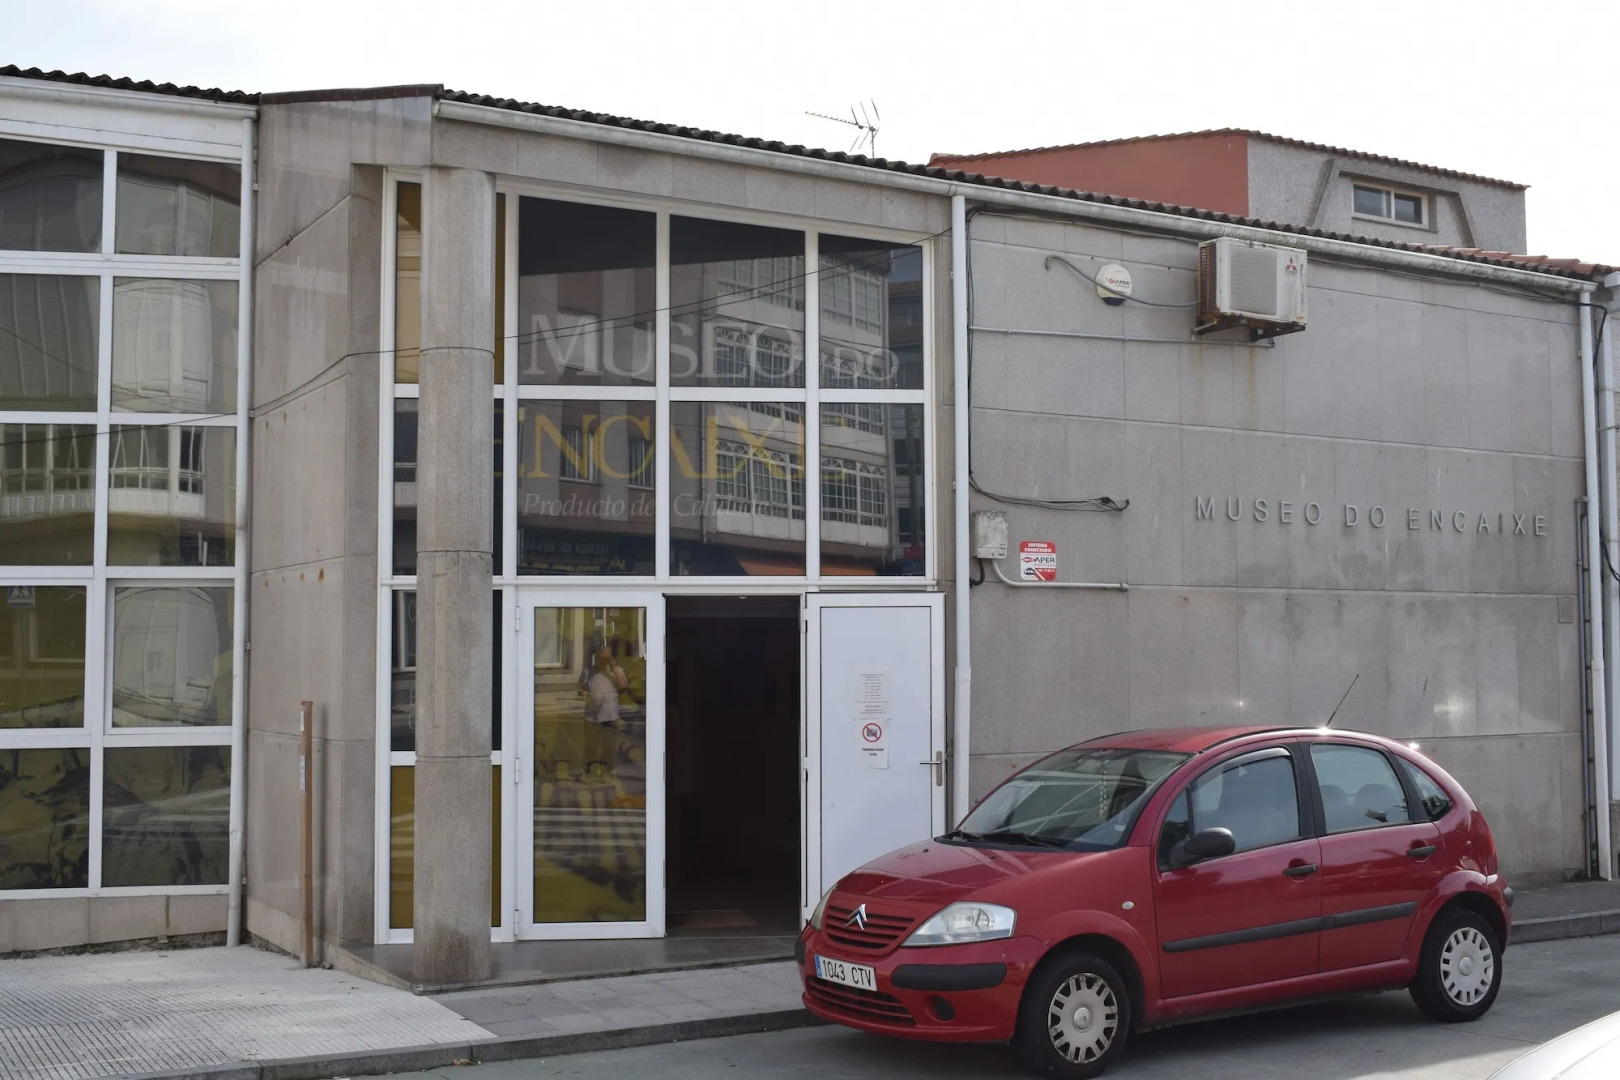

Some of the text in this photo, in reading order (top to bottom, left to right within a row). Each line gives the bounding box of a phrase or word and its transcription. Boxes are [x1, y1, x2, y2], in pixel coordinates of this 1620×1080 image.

[523, 313, 898, 381] MUSEO DO
[521, 492, 625, 517] Producto
[630, 492, 655, 517] de
[1195, 496, 1547, 537] MUSEO DO ENCAIXE
[1034, 556, 1055, 564] APER
[822, 959, 871, 987] 1043 CTV
